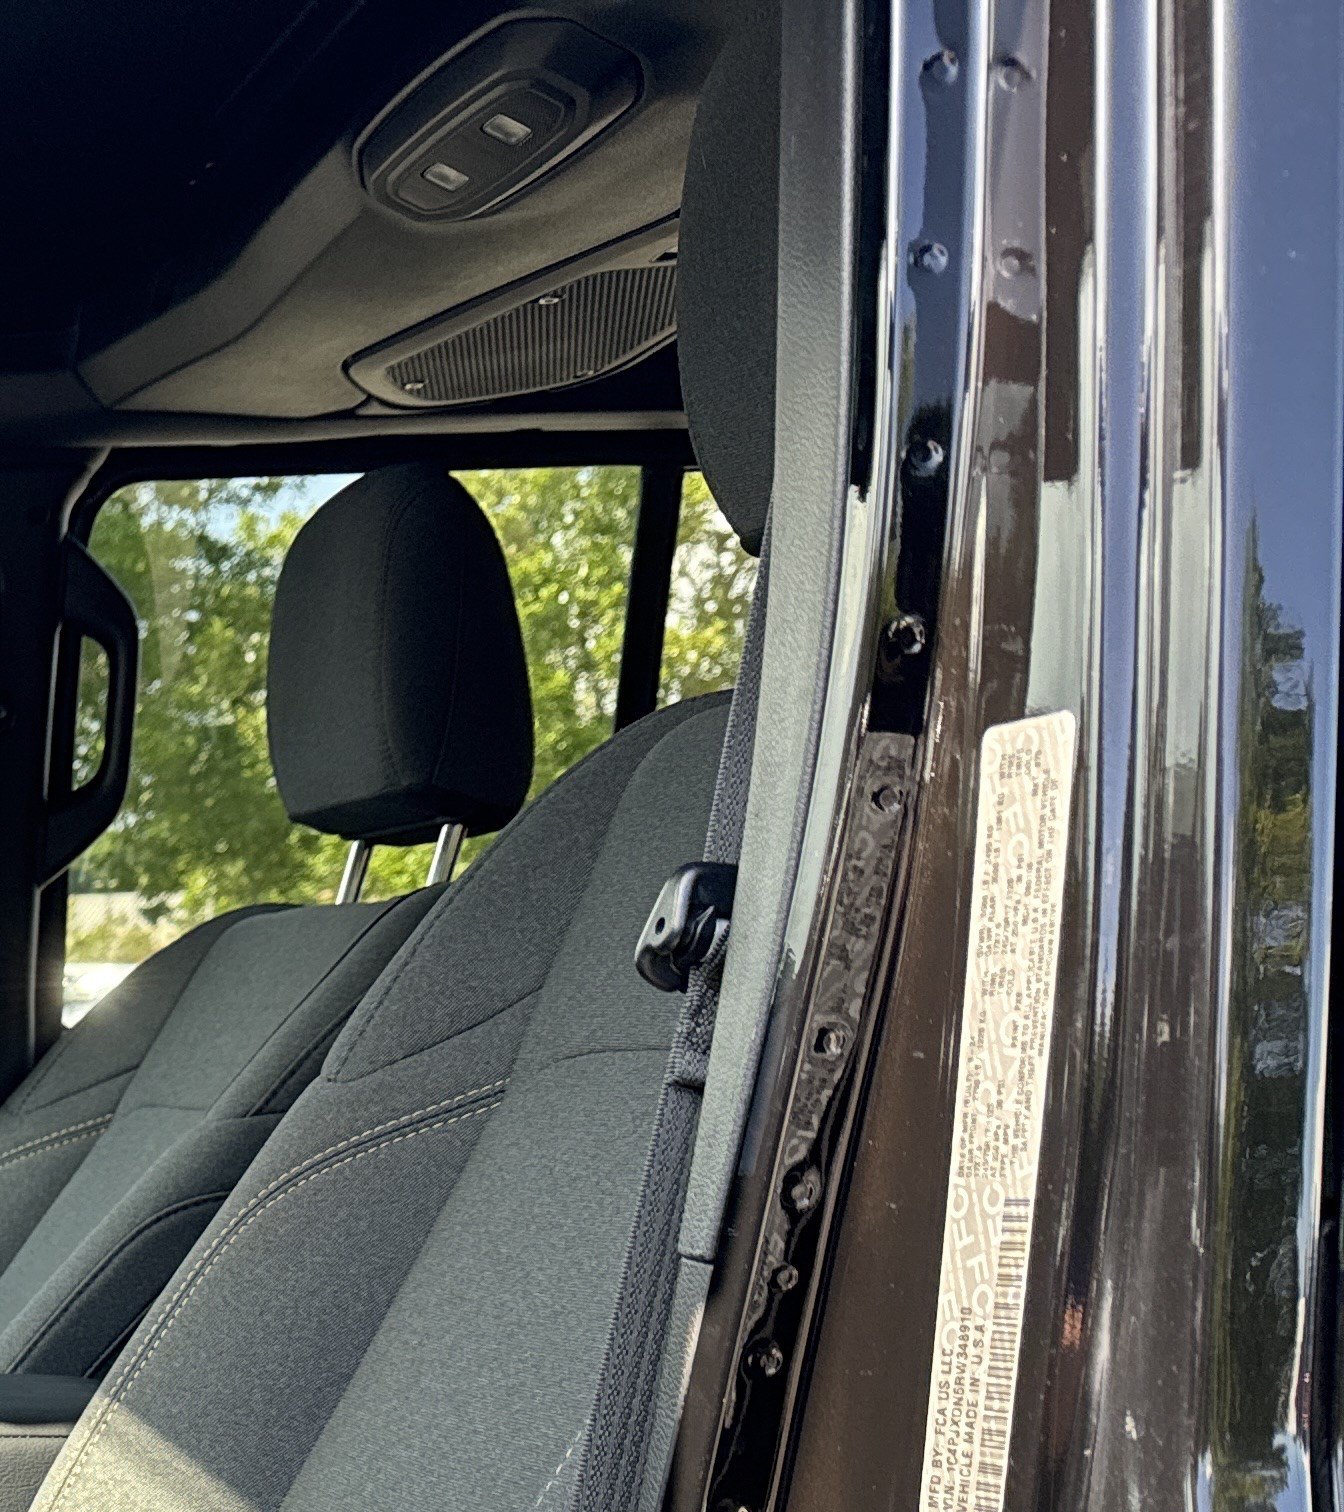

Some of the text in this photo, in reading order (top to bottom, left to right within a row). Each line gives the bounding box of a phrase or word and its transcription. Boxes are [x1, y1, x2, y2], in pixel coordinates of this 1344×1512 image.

[939, 1347, 953, 1374] LLC
[937, 1379, 950, 1400] US
[934, 1406, 948, 1436] FCA
[942, 1306, 972, 1511] VIN: 1C4PJXDN6RW348910
[961, 1399, 977, 1444] MADE
[927, 1474, 941, 1508] MFD
